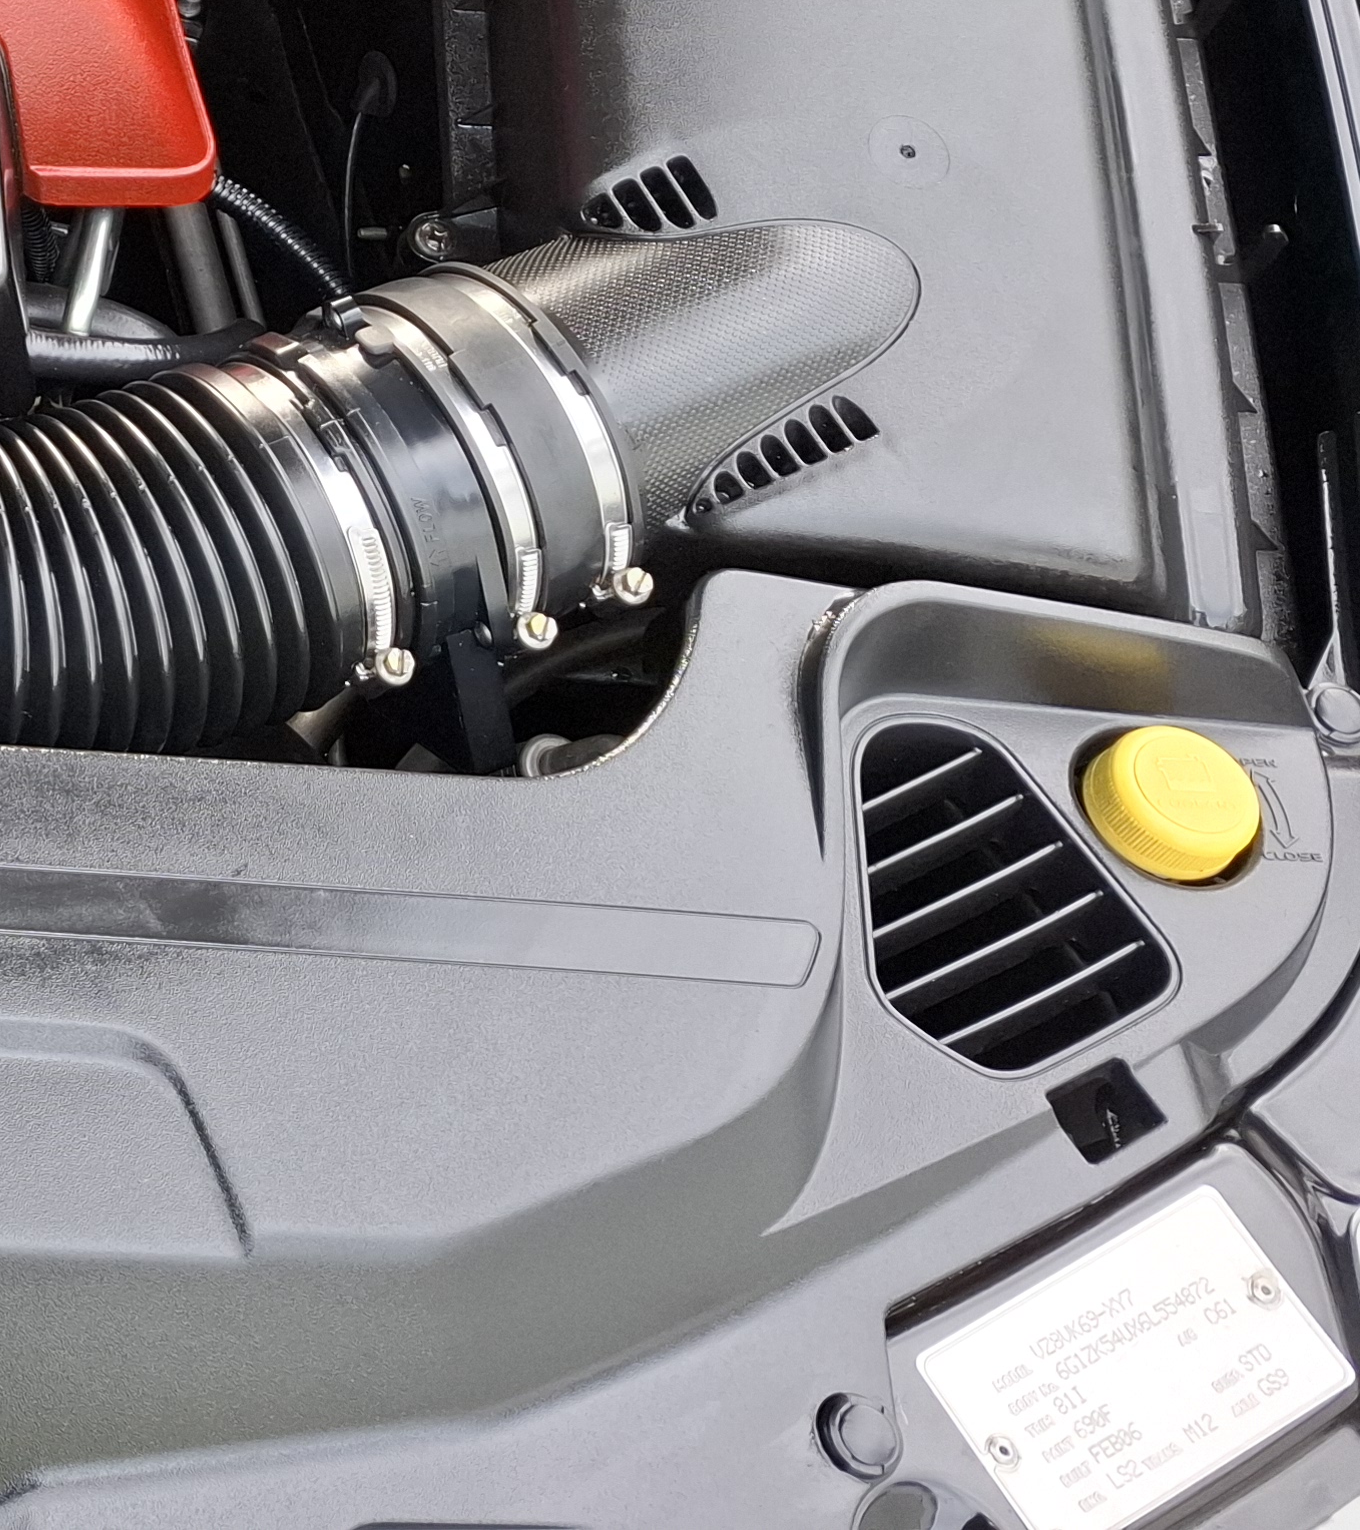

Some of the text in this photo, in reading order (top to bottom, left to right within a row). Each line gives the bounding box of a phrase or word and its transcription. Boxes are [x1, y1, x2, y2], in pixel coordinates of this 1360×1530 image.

[1261, 850, 1323, 862] CLOSE
[1028, 1285, 1138, 1363] VZ8VK69-XY7
[1052, 1273, 1216, 1383] 6G1ZK54UX6L554872
[1086, 1419, 1145, 1466] FEB06
[1105, 1455, 1145, 1491] LS2
[1180, 1410, 1220, 1446] M12
[1254, 1365, 1293, 1400] GS9
